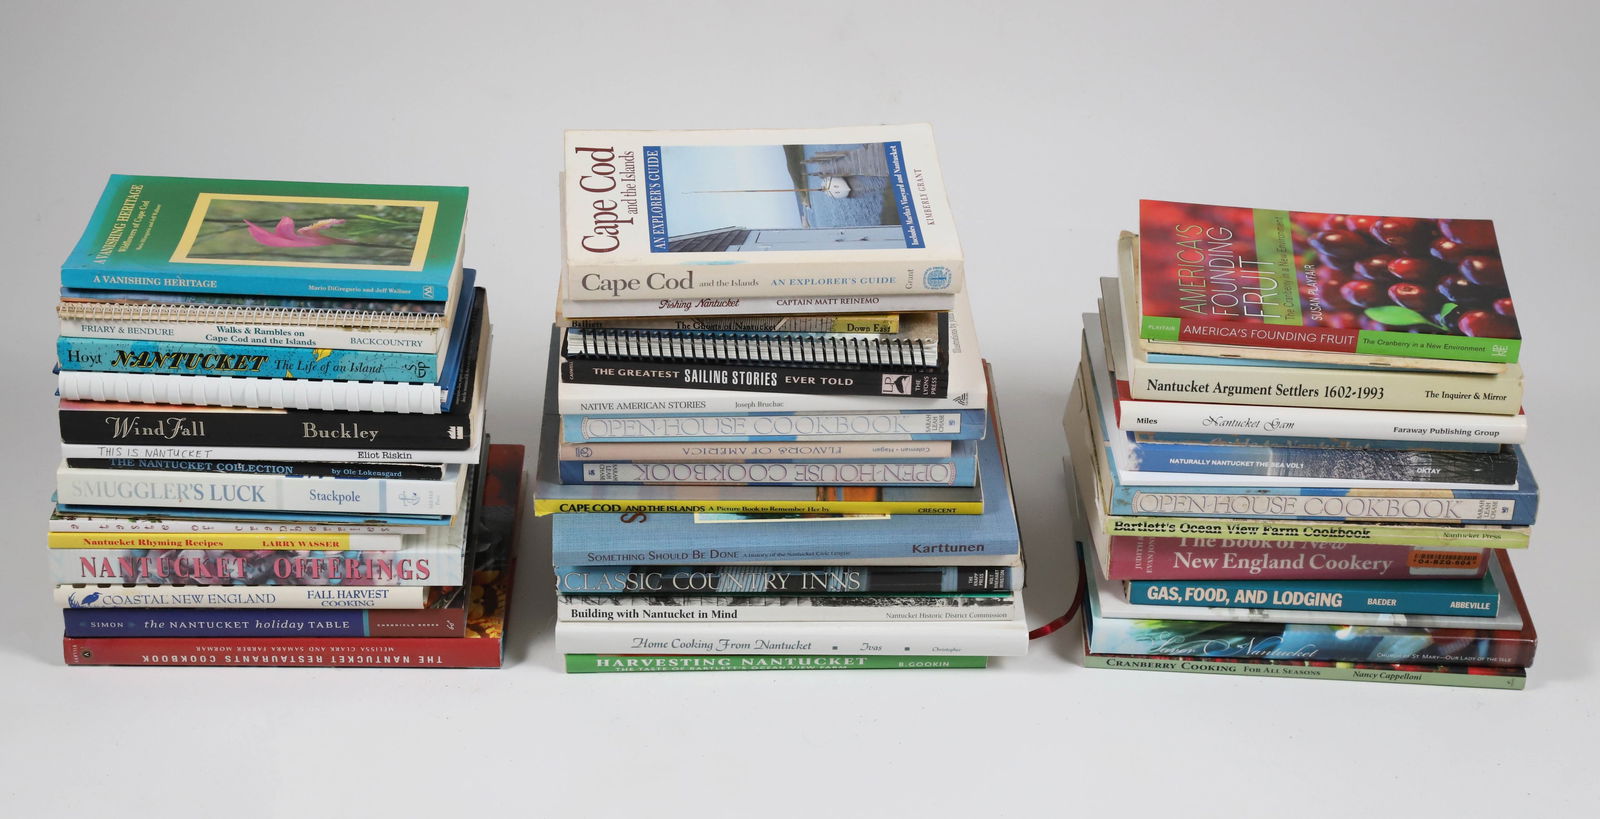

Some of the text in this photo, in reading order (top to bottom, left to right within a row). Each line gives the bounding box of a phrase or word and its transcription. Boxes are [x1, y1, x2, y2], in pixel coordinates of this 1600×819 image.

[618, 150, 638, 215] and the Islands
[575, 146, 634, 253] Cape Cod
[1176, 224, 1208, 316] AMERICA'S
[1206, 226, 1240, 316] FOUNDING
[93, 275, 218, 288] A VANISHING HERITAGE
[581, 272, 640, 297] Cape
[646, 270, 694, 290] Cod
[716, 279, 730, 287] the
[731, 278, 760, 287] Islands
[770, 276, 896, 286] AN EXPLORER'S GUIDE
[904, 268, 914, 290] Grant
[1238, 255, 1281, 318] FRUIT
[840, 297, 880, 305] REINEMO
[81, 324, 116, 334] FRIARY
[127, 327, 174, 336] BENDURE
[676, 321, 776, 332] The Ghosts of Nantucket
[847, 324, 892, 332] Down East
[205, 334, 317, 347] Cape Cod and the Islands
[1183, 325, 1355, 346] AMERICA'S FOUNDING FRUIT
[350, 336, 424, 348] BACKCOUNTRY
[1377, 338, 1410, 348] Cranberry
[1426, 342, 1442, 350] New
[1444, 343, 1486, 352] Environment
[593, 367, 854, 387] THE GREATEST SAILING STORIES EVER TOLD
[1147, 379, 1384, 400] Nantucket Argument Settlers 1602-1993
[1424, 390, 1508, 401] The Inquirer & Mirror
[580, 402, 614, 412] NATIVE
[616, 402, 666, 411] AMERICAN
[668, 401, 706, 409] STORIES
[735, 401, 756, 410] Joseph
[1136, 416, 1158, 425] Miles
[302, 422, 380, 442] Buckley
[1393, 426, 1500, 438] Faraway Publishing Group
[98, 446, 213, 459] THIS IS NANTUCKET
[358, 450, 412, 460] Eliot Riskin
[682, 446, 842, 456] FLAVORS OF AMERICA
[1169, 458, 1210, 466] NATURALLY
[1211, 459, 1254, 468] NANTUCKET
[1416, 467, 1442, 475] OKTAY
[72, 480, 266, 502] SMUGGLER'S LUCK
[309, 489, 361, 504] Stackpole
[138, 538, 184, 548] Rhyming
[185, 540, 224, 548] Recipes
[912, 543, 985, 555] Karttunen
[588, 550, 738, 562] SOMETHING SHOULD BE DONE
[80, 556, 430, 580] NANTUCKET OFFERINGS
[1173, 551, 1394, 576] New England Cookery
[564, 572, 860, 592] CLASSIC COUNTRY INNS
[102, 593, 276, 606] COASTAL NEW ENGLAND
[307, 589, 390, 600] FALL HARVEST
[1147, 586, 1342, 608] GAS, FOOD, AND LODGING
[1367, 598, 1397, 606] BAEDER
[1450, 601, 1490, 610] ABBEVILLE
[571, 608, 738, 620] Building with Nantucket in Mind
[144, 620, 165, 629] the
[255, 620, 304, 631] holiday
[225, 655, 322, 664] RESTAURANTS
[332, 656, 410, 664] NANTUCKET
[418, 656, 442, 664] THE
[597, 657, 868, 668] HARVESTING NANTUCKET
[1106, 658, 1177, 670] CRANBERRY
[1180, 661, 1236, 672] COOKING
[1282, 668, 1321, 676] SEASONS
